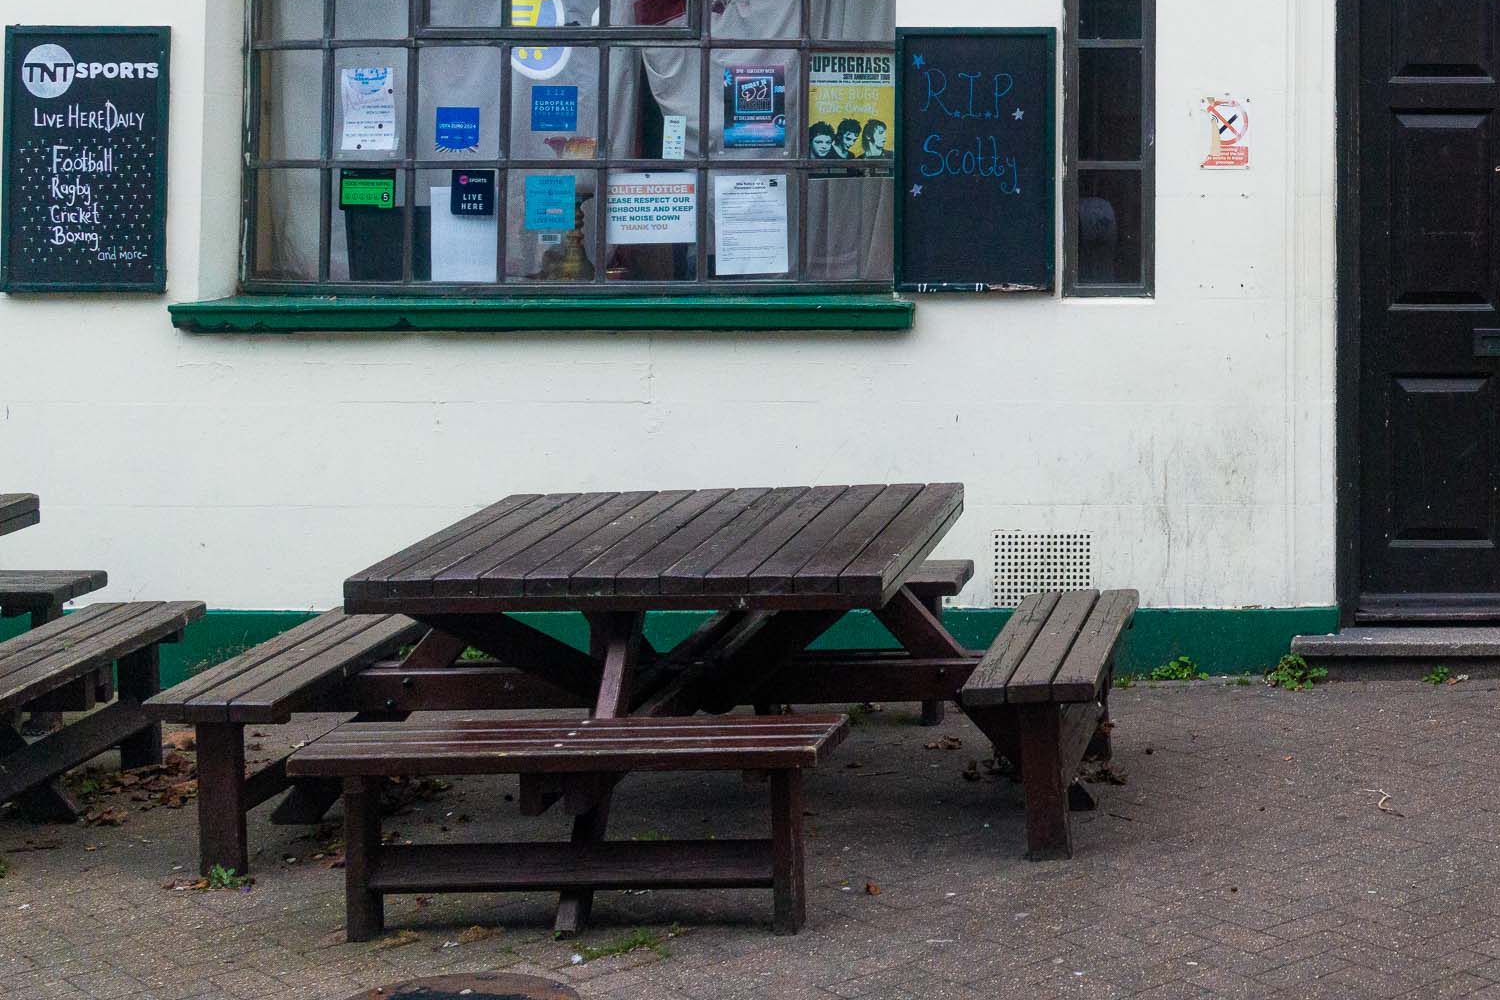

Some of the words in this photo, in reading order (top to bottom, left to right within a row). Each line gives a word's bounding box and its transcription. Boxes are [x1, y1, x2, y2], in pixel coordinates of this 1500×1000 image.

[24, 63, 74, 82] TNT
[75, 62, 159, 79] SPORTS
[52, 145, 113, 173] Football
[920, 135, 1018, 194] Scotty
[51, 176, 91, 206] Rugby
[646, 185, 688, 193] NOTICE
[50, 202, 101, 224] Cricket
[50, 226, 98, 251] Boxing
[97, 247, 117, 261] and
